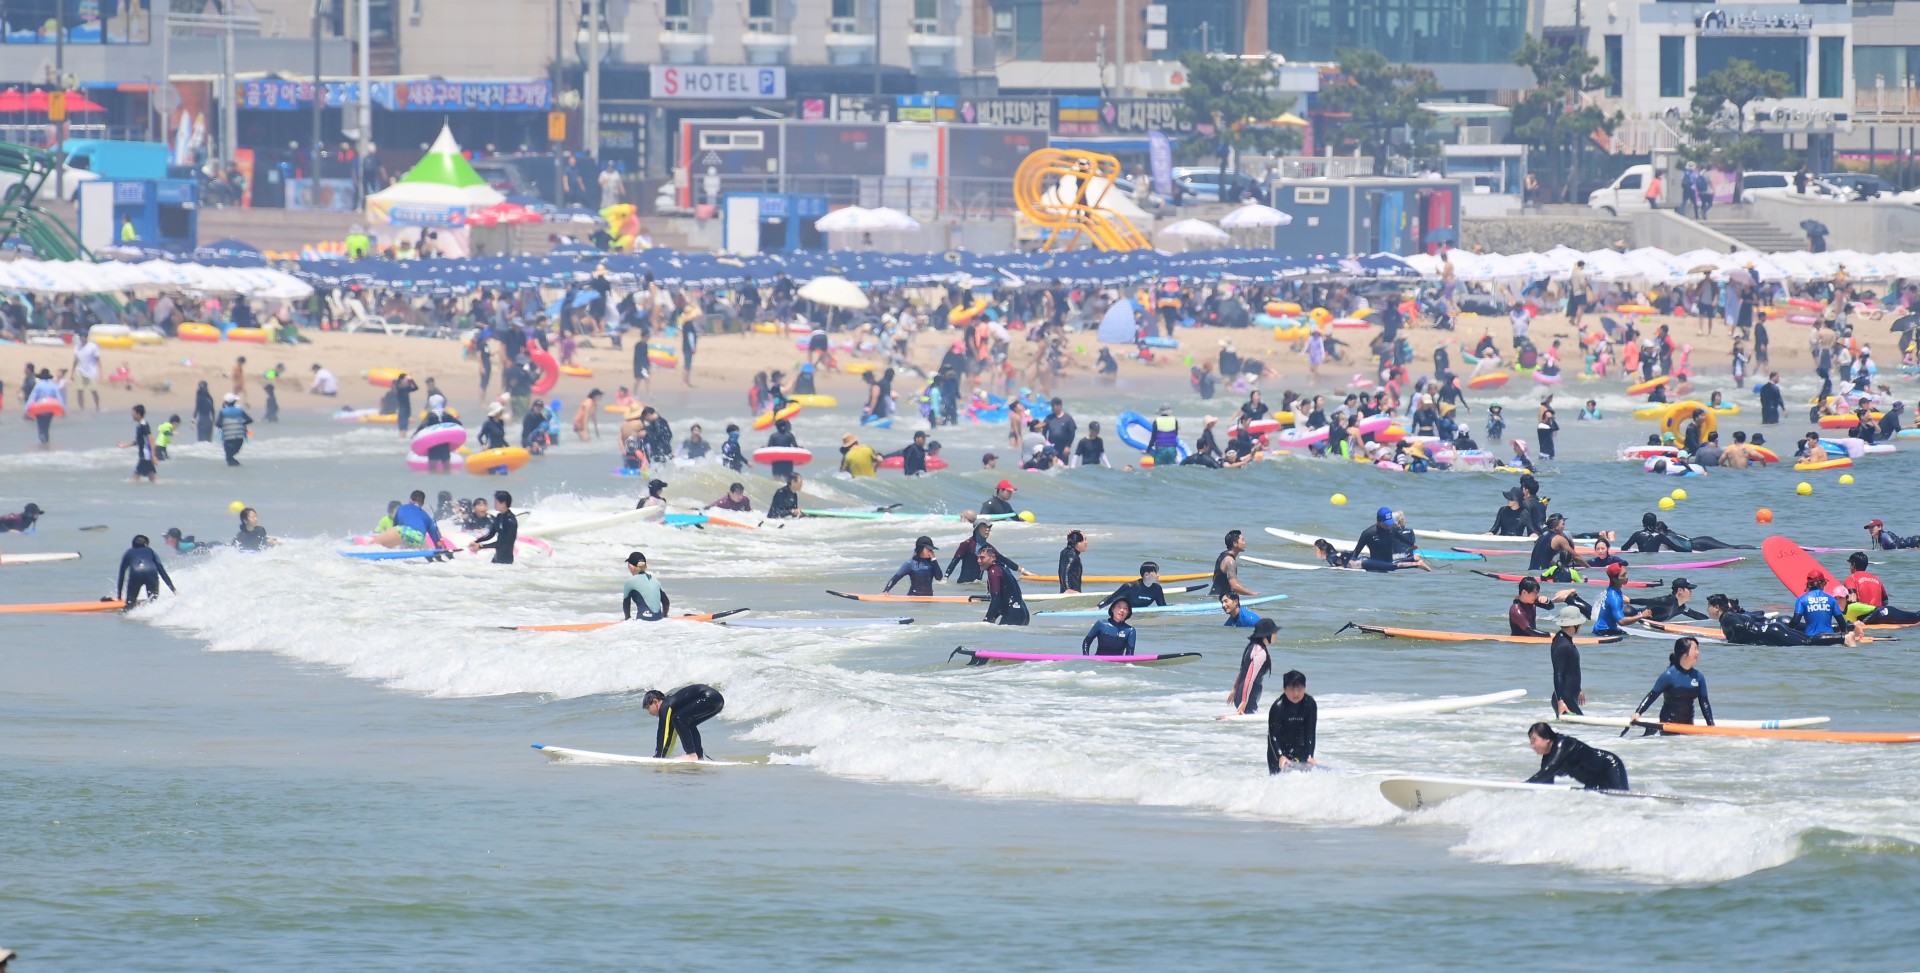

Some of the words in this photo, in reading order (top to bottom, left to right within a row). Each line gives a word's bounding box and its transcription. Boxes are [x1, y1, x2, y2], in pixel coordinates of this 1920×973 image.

[664, 68, 678, 94] S
[685, 73, 749, 91] HOTEL
[1807, 604, 1831, 612] HOLIC
